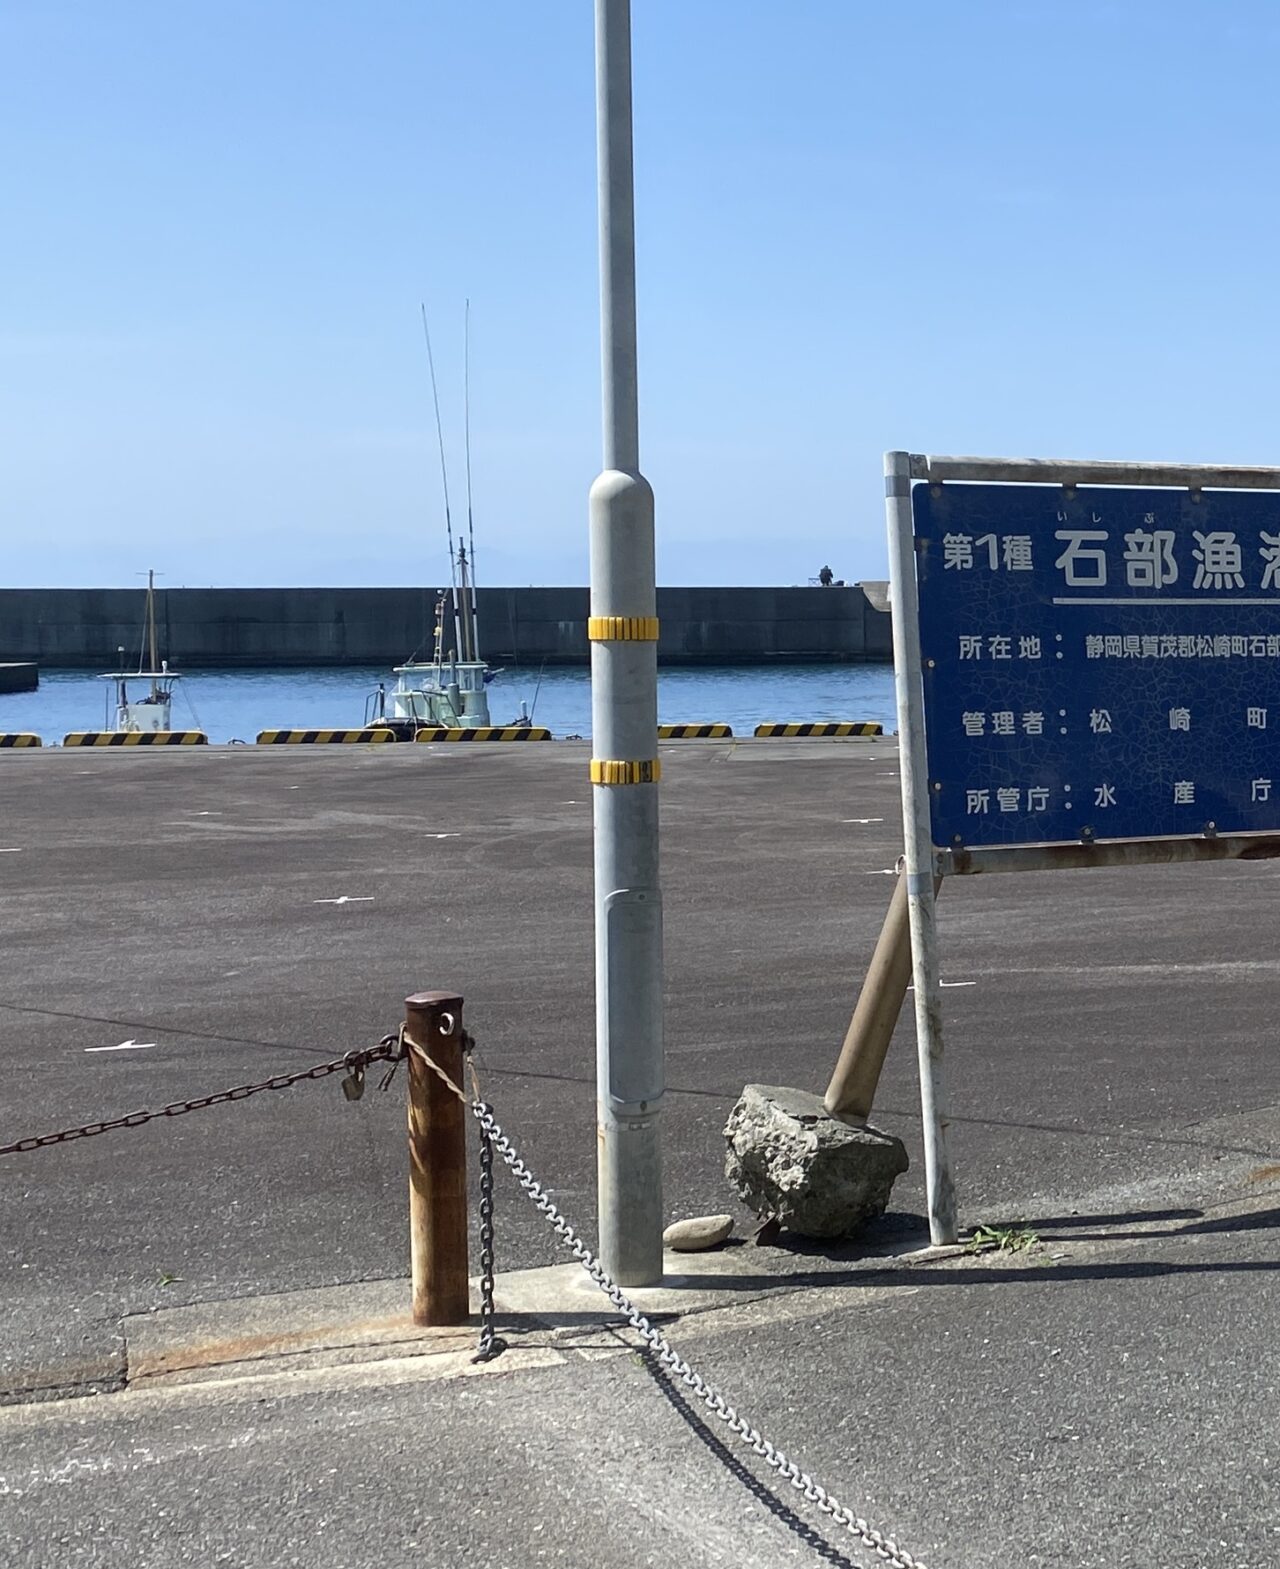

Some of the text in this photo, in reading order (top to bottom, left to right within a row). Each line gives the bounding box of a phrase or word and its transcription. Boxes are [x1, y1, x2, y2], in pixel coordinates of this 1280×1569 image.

[942, 532, 1034, 572] 第1種
[1089, 706, 1268, 734] 松崎町
[1093, 777, 1273, 808] 水産庁
